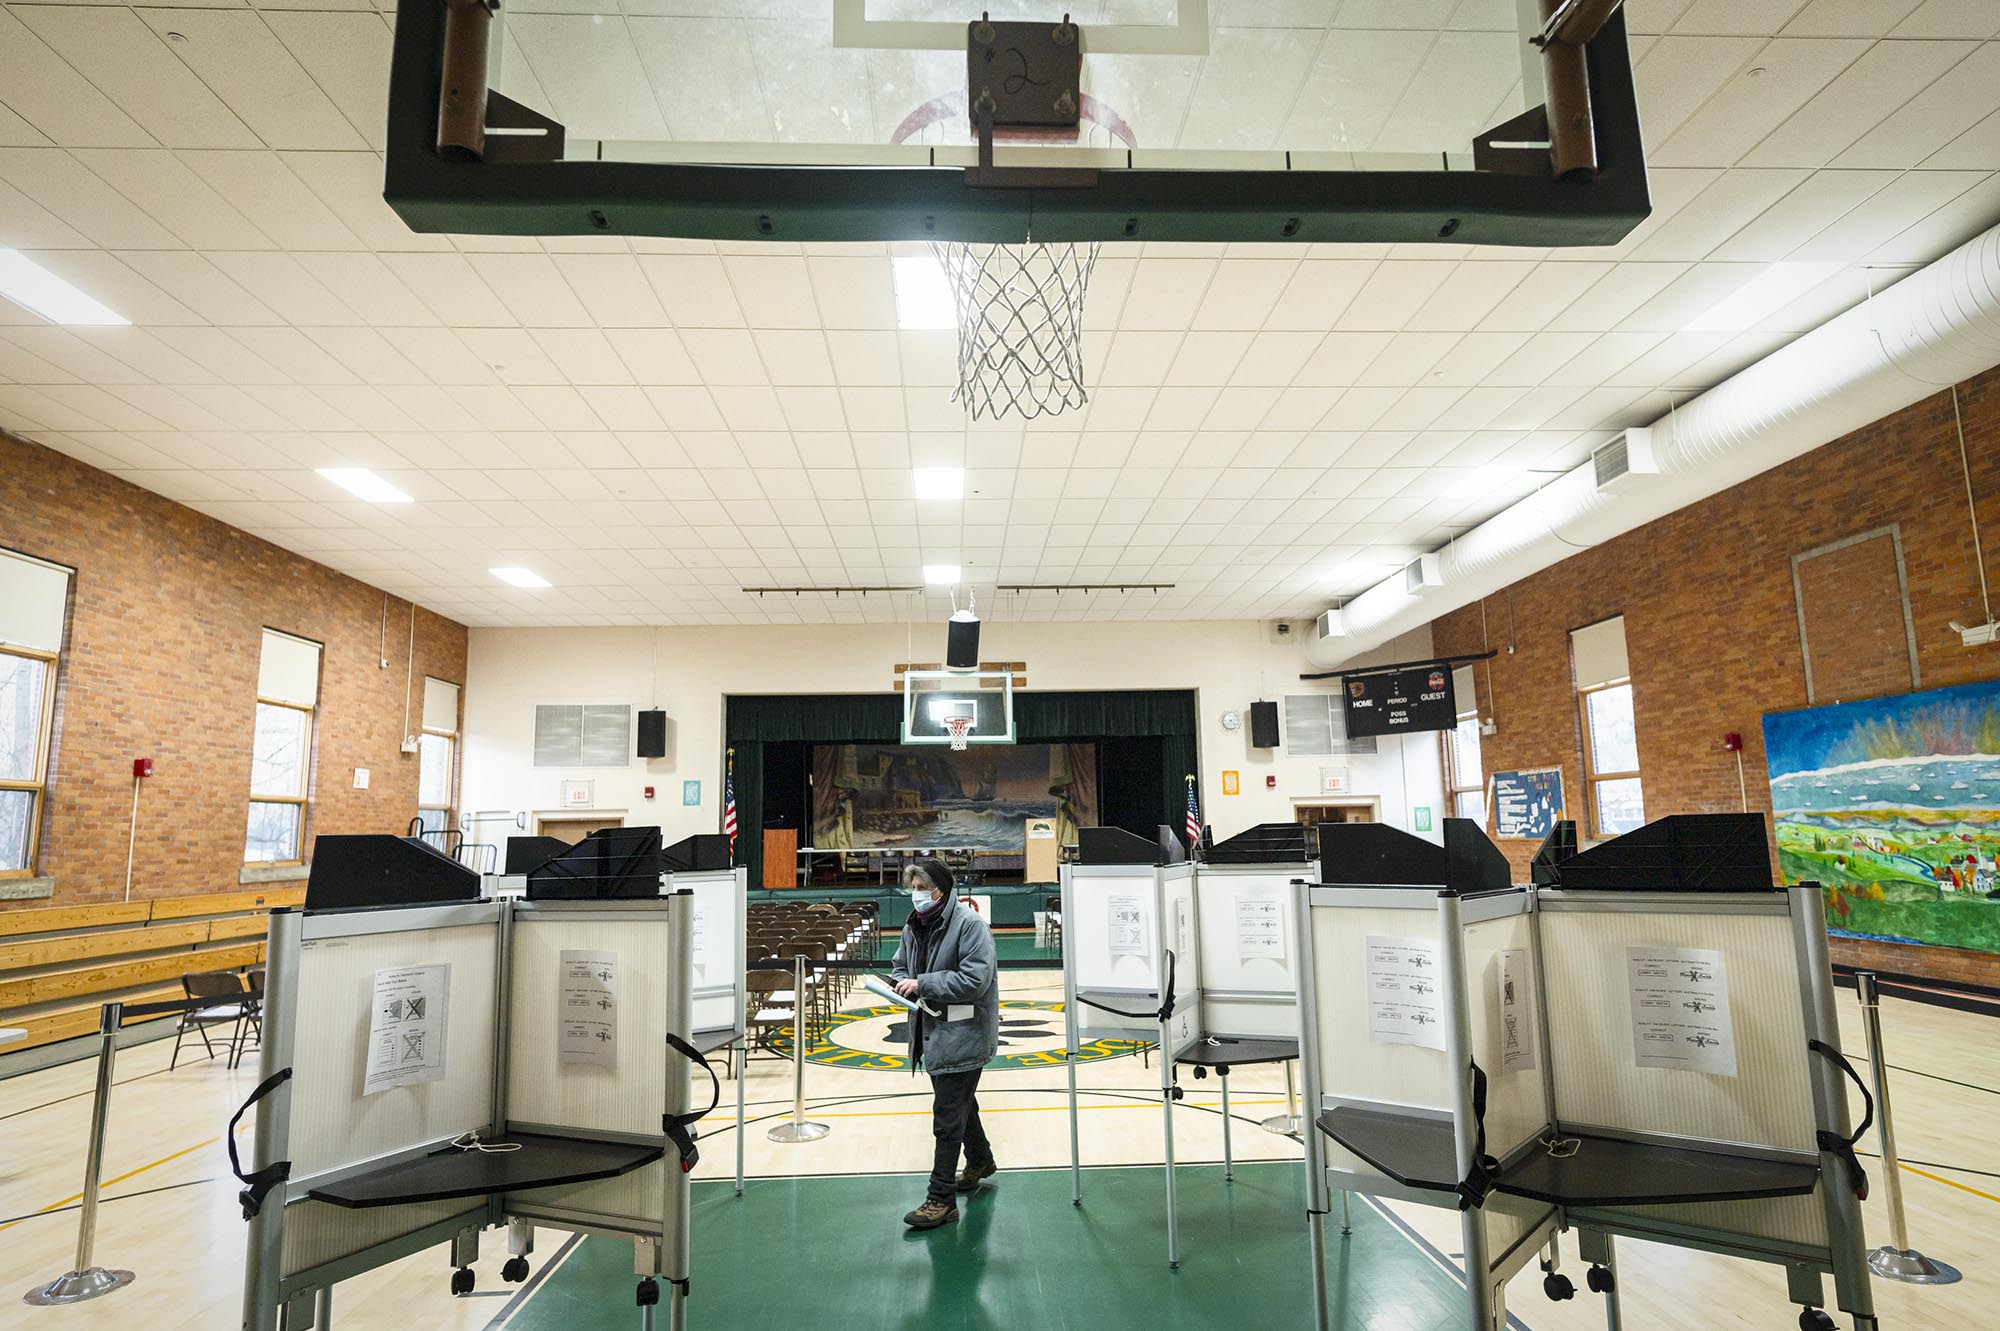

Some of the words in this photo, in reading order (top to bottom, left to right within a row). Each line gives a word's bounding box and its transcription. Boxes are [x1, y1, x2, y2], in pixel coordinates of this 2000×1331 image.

[1004, 47, 1051, 95] 2
[1421, 692, 1445, 701] GUEST
[1353, 699, 1373, 708] HOME
[1389, 717, 1409, 725] BONUS
[573, 791, 586, 800] EXIT
